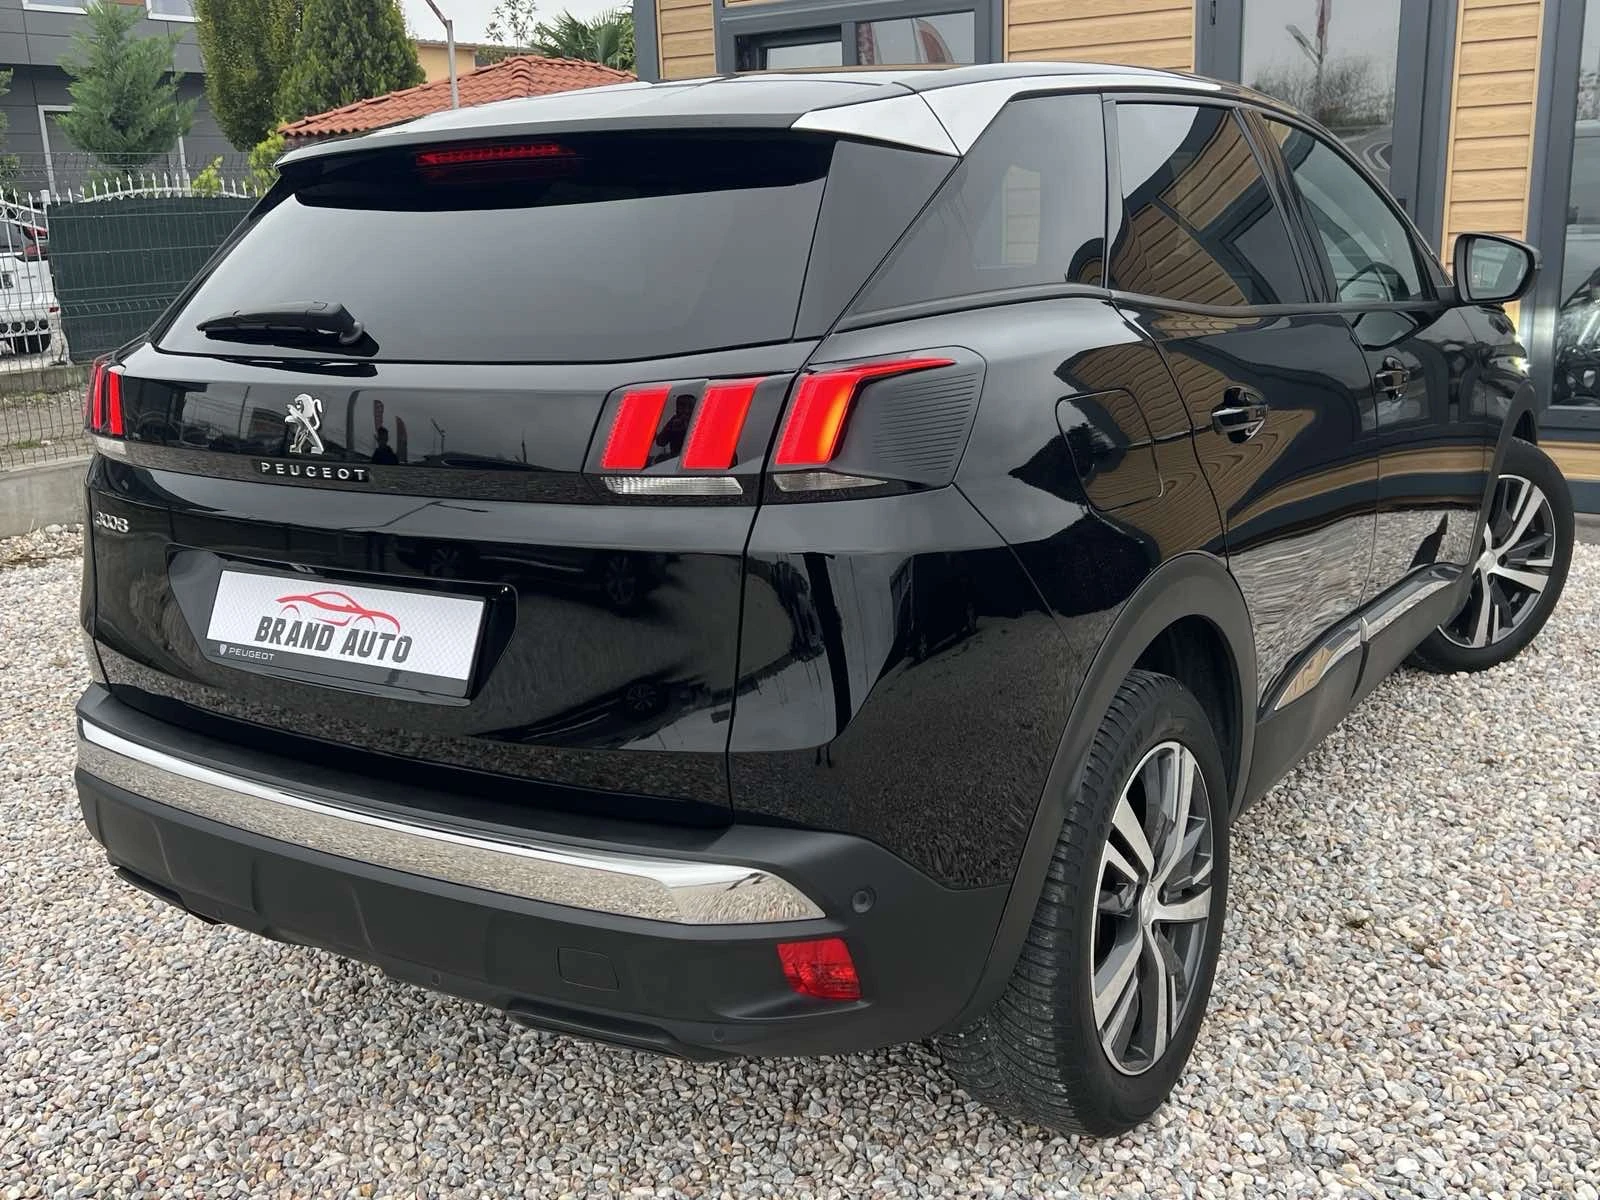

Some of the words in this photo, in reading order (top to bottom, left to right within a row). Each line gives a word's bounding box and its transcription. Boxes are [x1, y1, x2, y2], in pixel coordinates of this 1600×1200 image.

[260, 462, 367, 481] PEUGEOT
[254, 615, 335, 652] BRAND
[340, 628, 413, 663] AUTO
[228, 647, 275, 661] PEUGEOT
